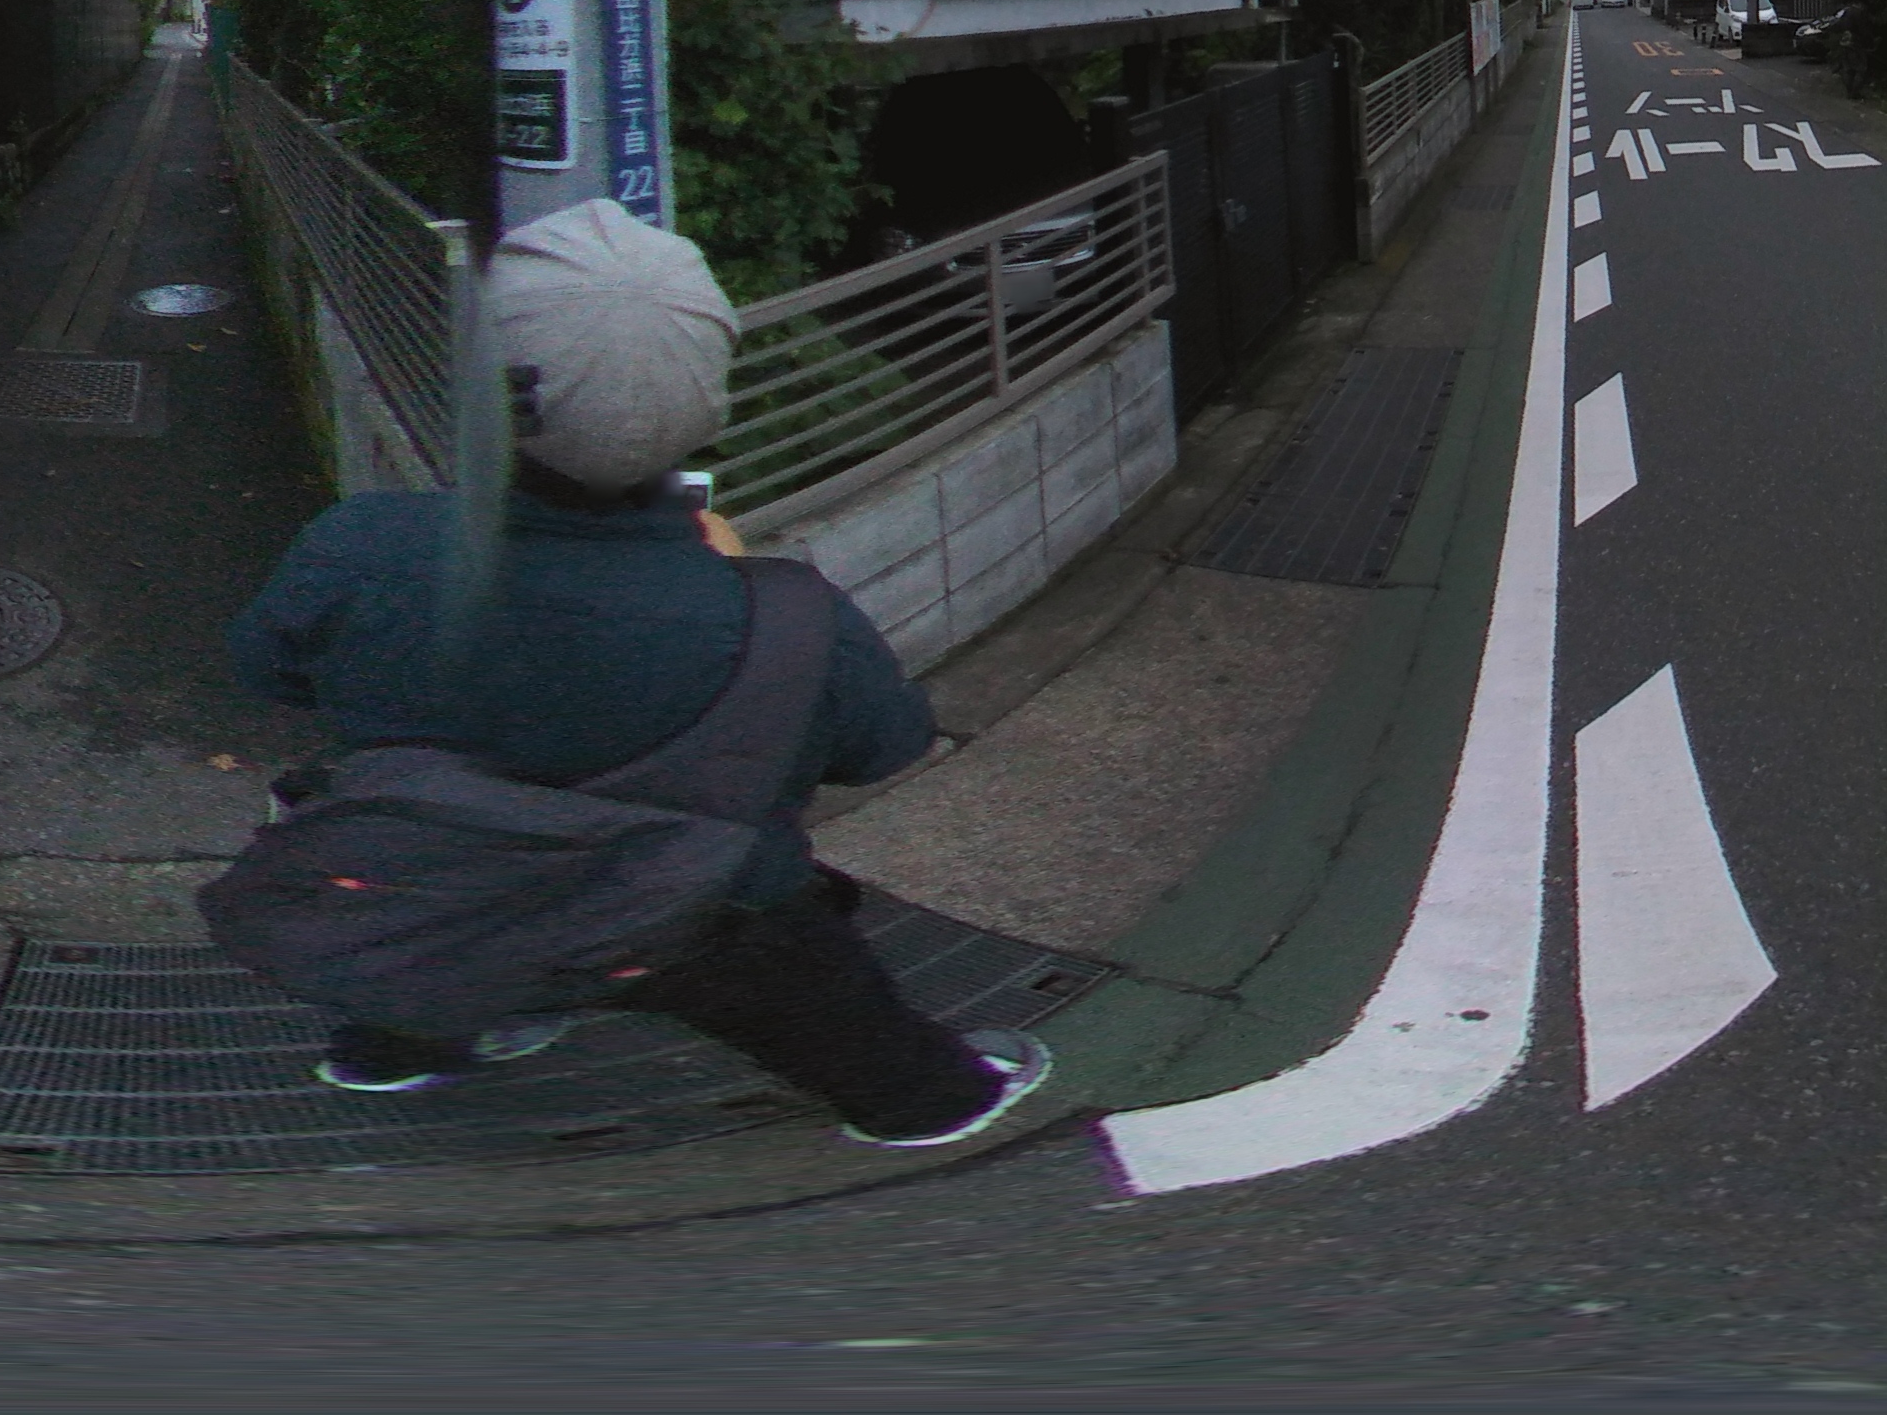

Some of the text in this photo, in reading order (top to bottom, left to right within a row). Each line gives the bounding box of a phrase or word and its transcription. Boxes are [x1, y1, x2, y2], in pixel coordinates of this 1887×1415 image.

[1604, 120, 1883, 181] スクール
[617, 165, 656, 202] 22
